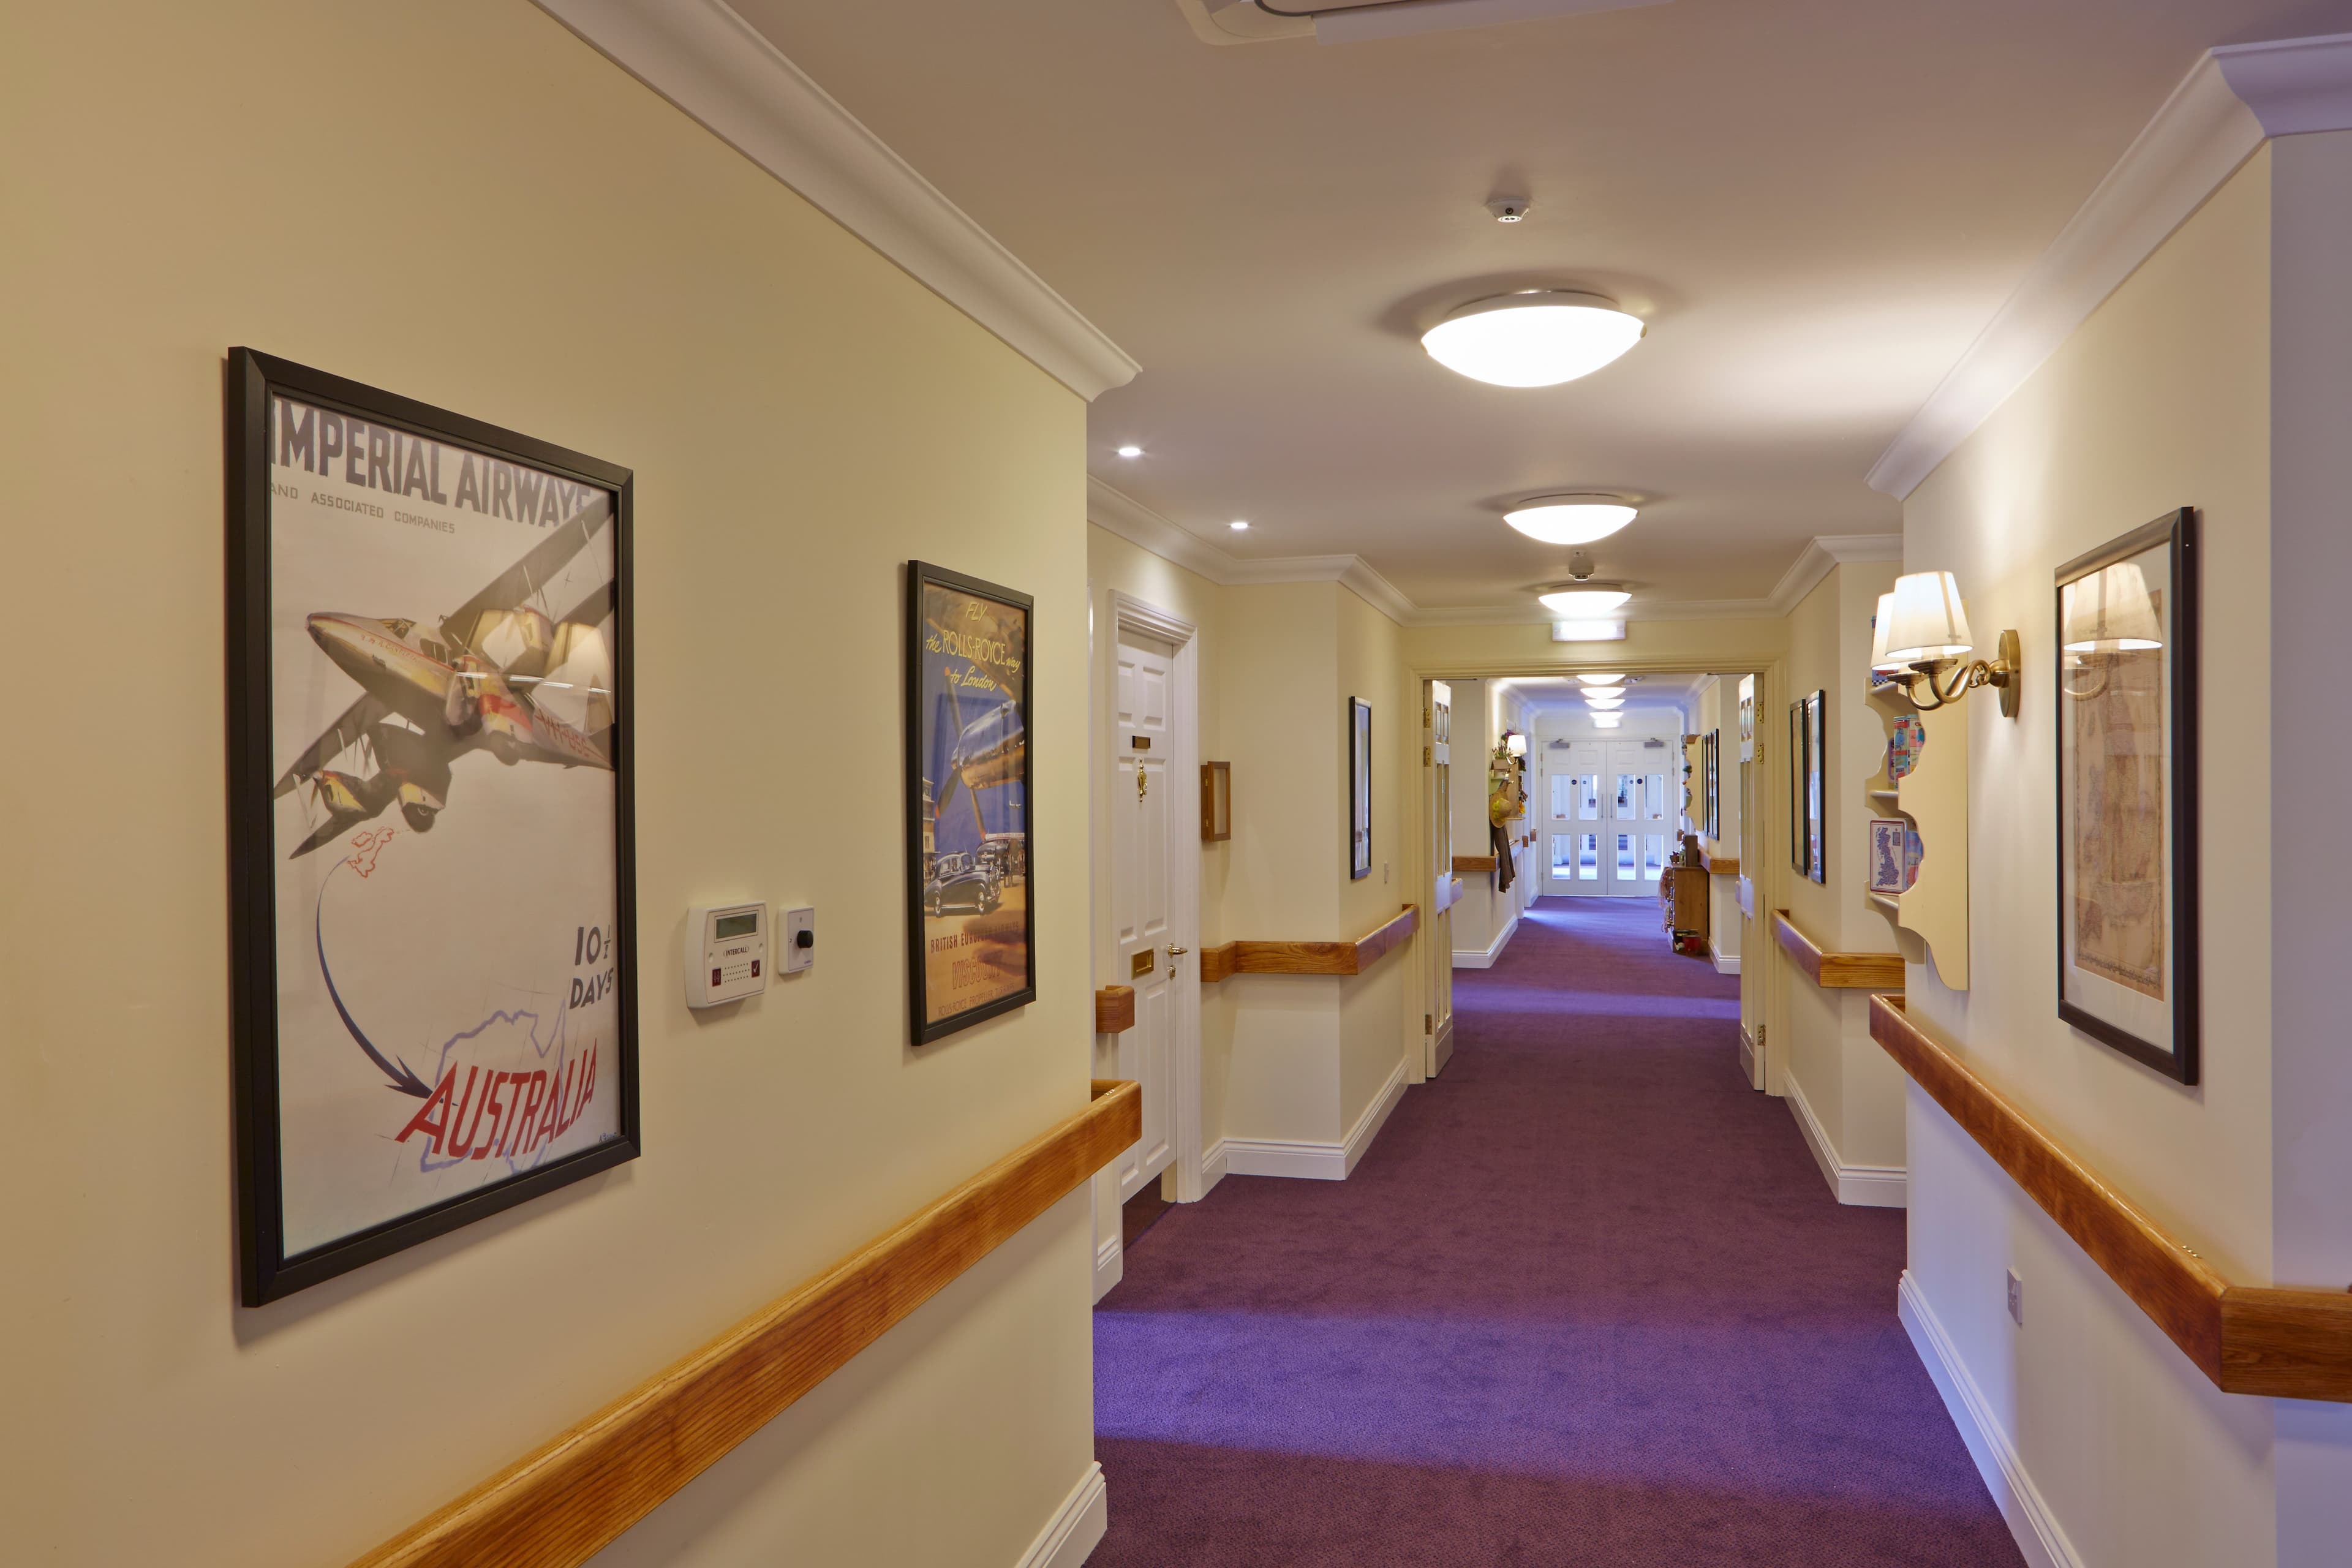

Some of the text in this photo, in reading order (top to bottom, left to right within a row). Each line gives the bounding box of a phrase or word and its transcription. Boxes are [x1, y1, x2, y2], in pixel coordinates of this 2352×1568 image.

[270, 482, 455, 534] AND ASSOCIATED COMPANIES
[965, 601, 987, 622] FLY
[925, 630, 1020, 673] the ROLLS-ROYCE way
[950, 666, 997, 692] to London
[725, 946, 748, 956] INTERCALL
[930, 934, 958, 954] BRITISH
[569, 967, 614, 1009] DAYS
[394, 1038, 597, 1161] AUSTRALIA
